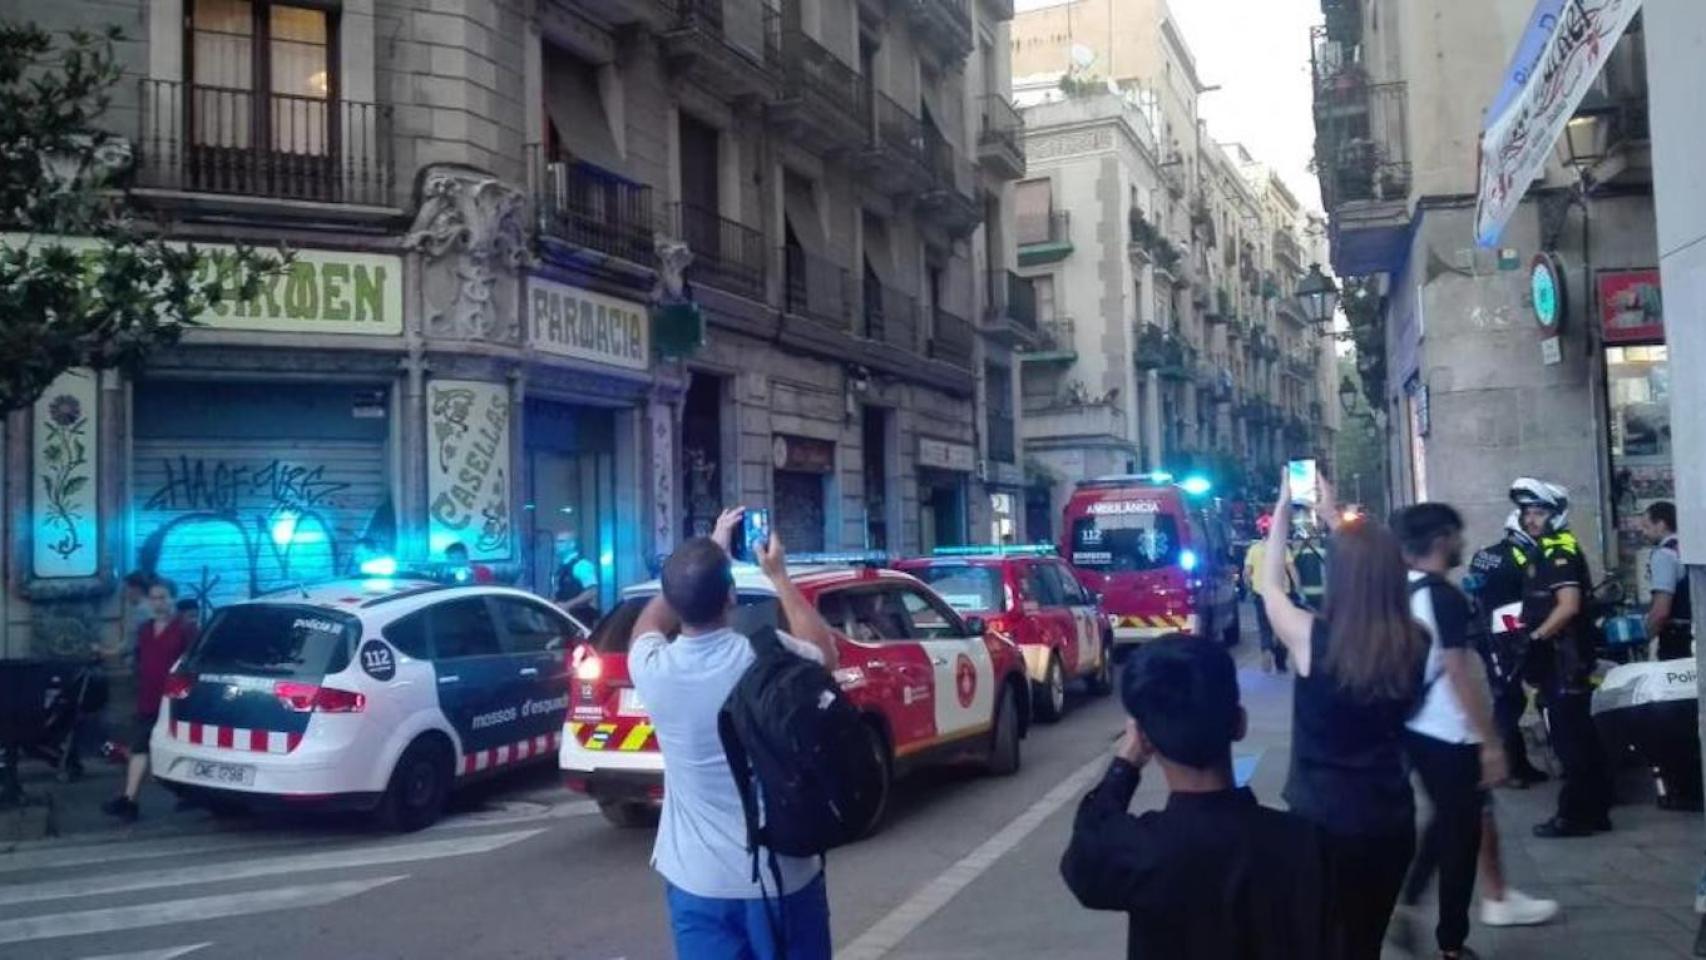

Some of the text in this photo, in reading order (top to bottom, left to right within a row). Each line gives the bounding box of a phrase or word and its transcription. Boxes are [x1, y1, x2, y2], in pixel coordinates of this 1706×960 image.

[432, 395, 508, 530] CASELLAS
[364, 649, 391, 666] 112
[472, 707, 517, 730] mossos
